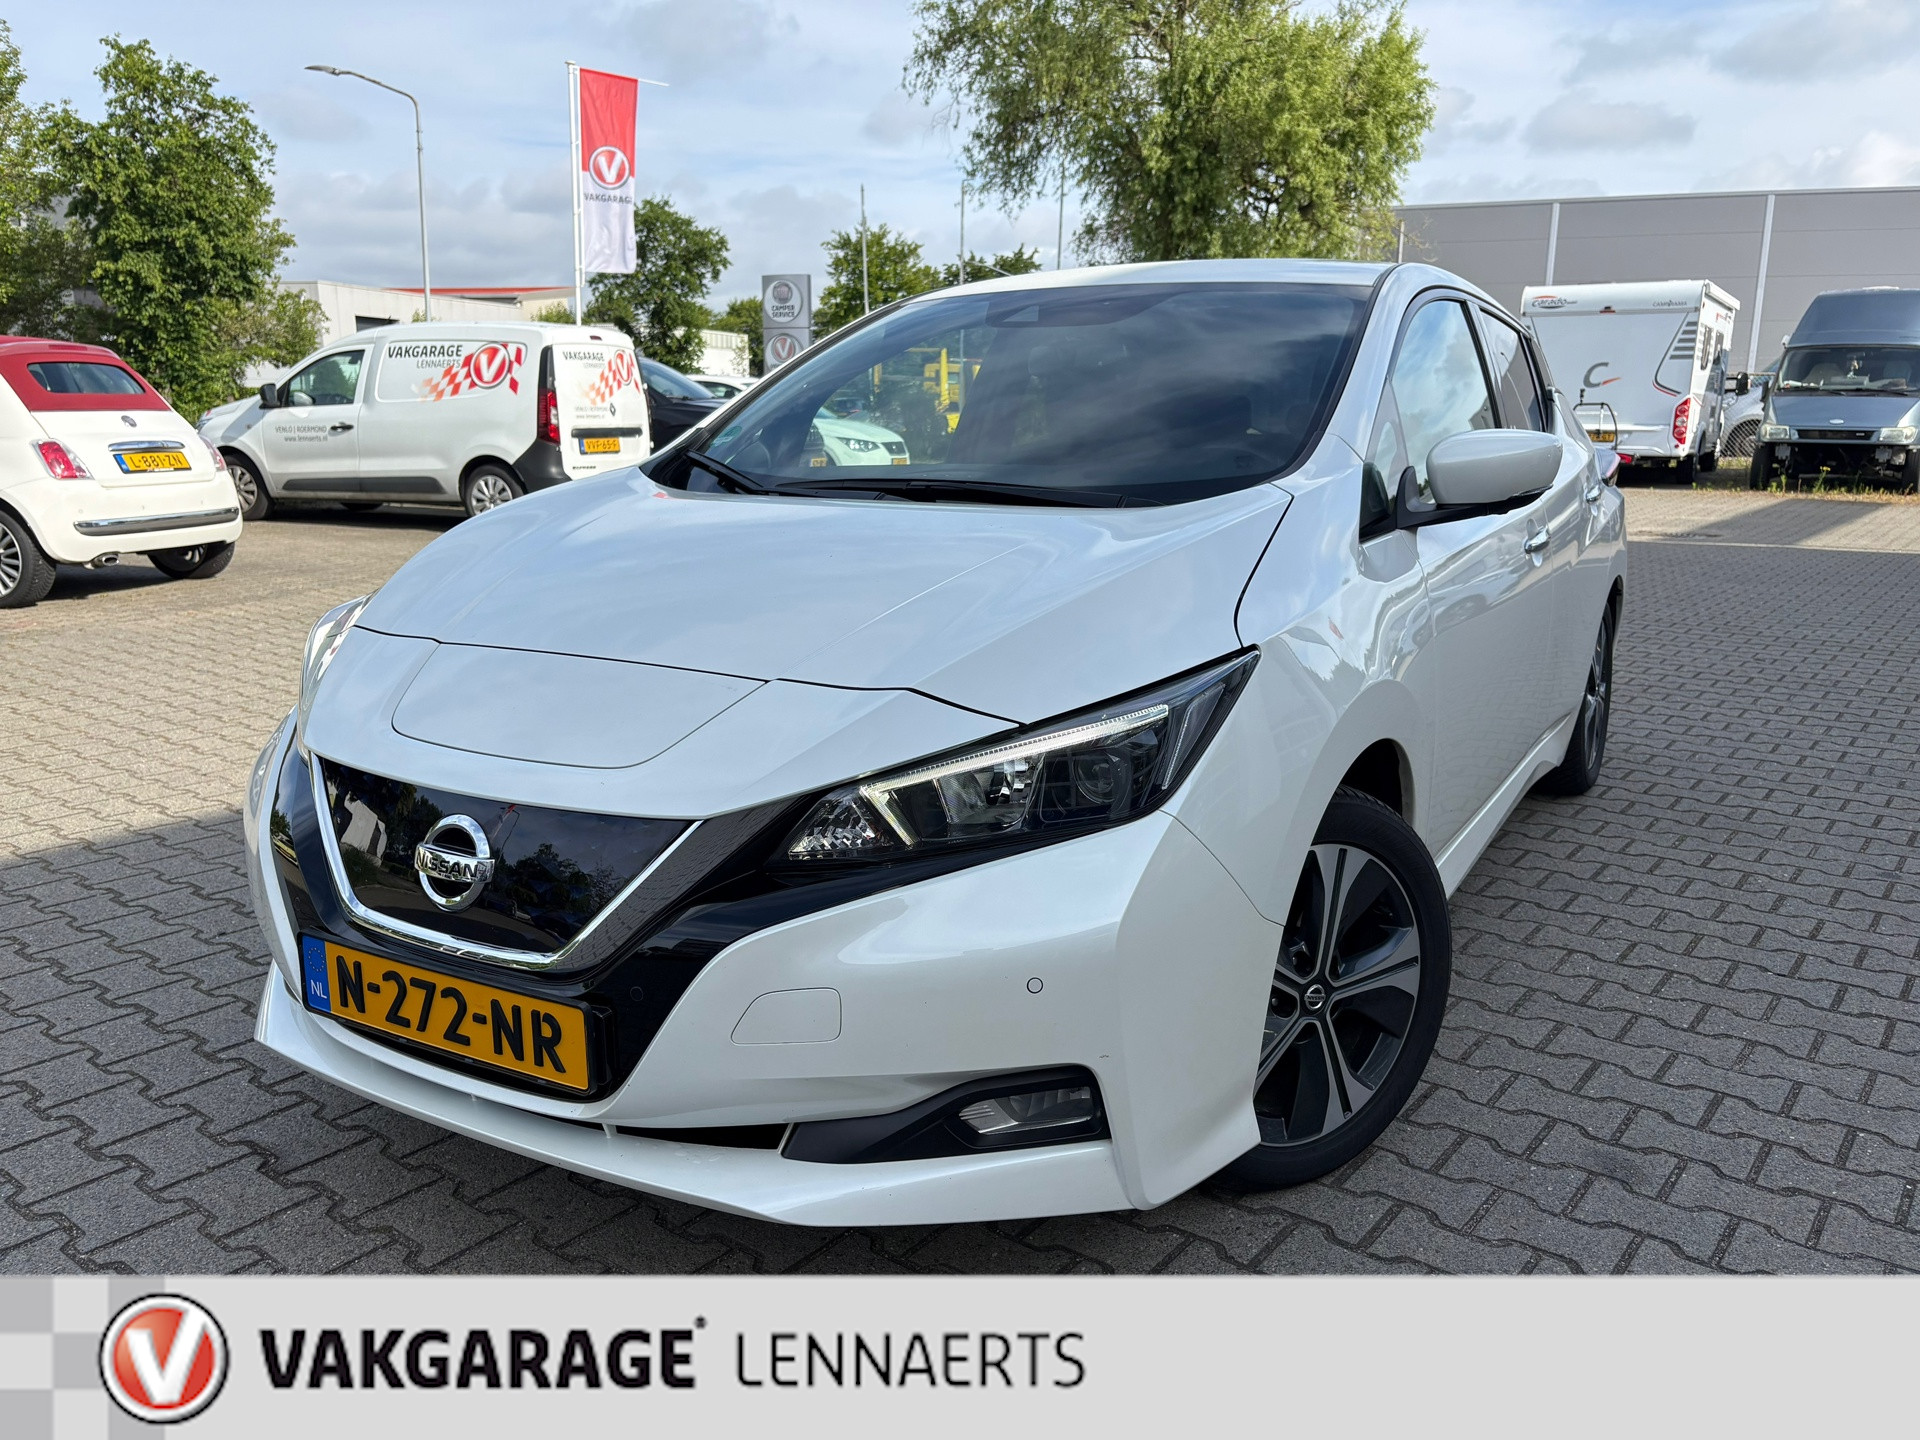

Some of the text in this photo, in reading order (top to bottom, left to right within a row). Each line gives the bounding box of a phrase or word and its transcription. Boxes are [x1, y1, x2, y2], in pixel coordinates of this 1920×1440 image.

[388, 345, 463, 359] VAKGARAGE
[416, 359, 462, 370] LENNAERTS
[129, 455, 183, 468] L-881-ZN
[416, 848, 479, 878] NISSAN
[310, 979, 328, 999] NL
[336, 954, 567, 1074] N-272-NR
